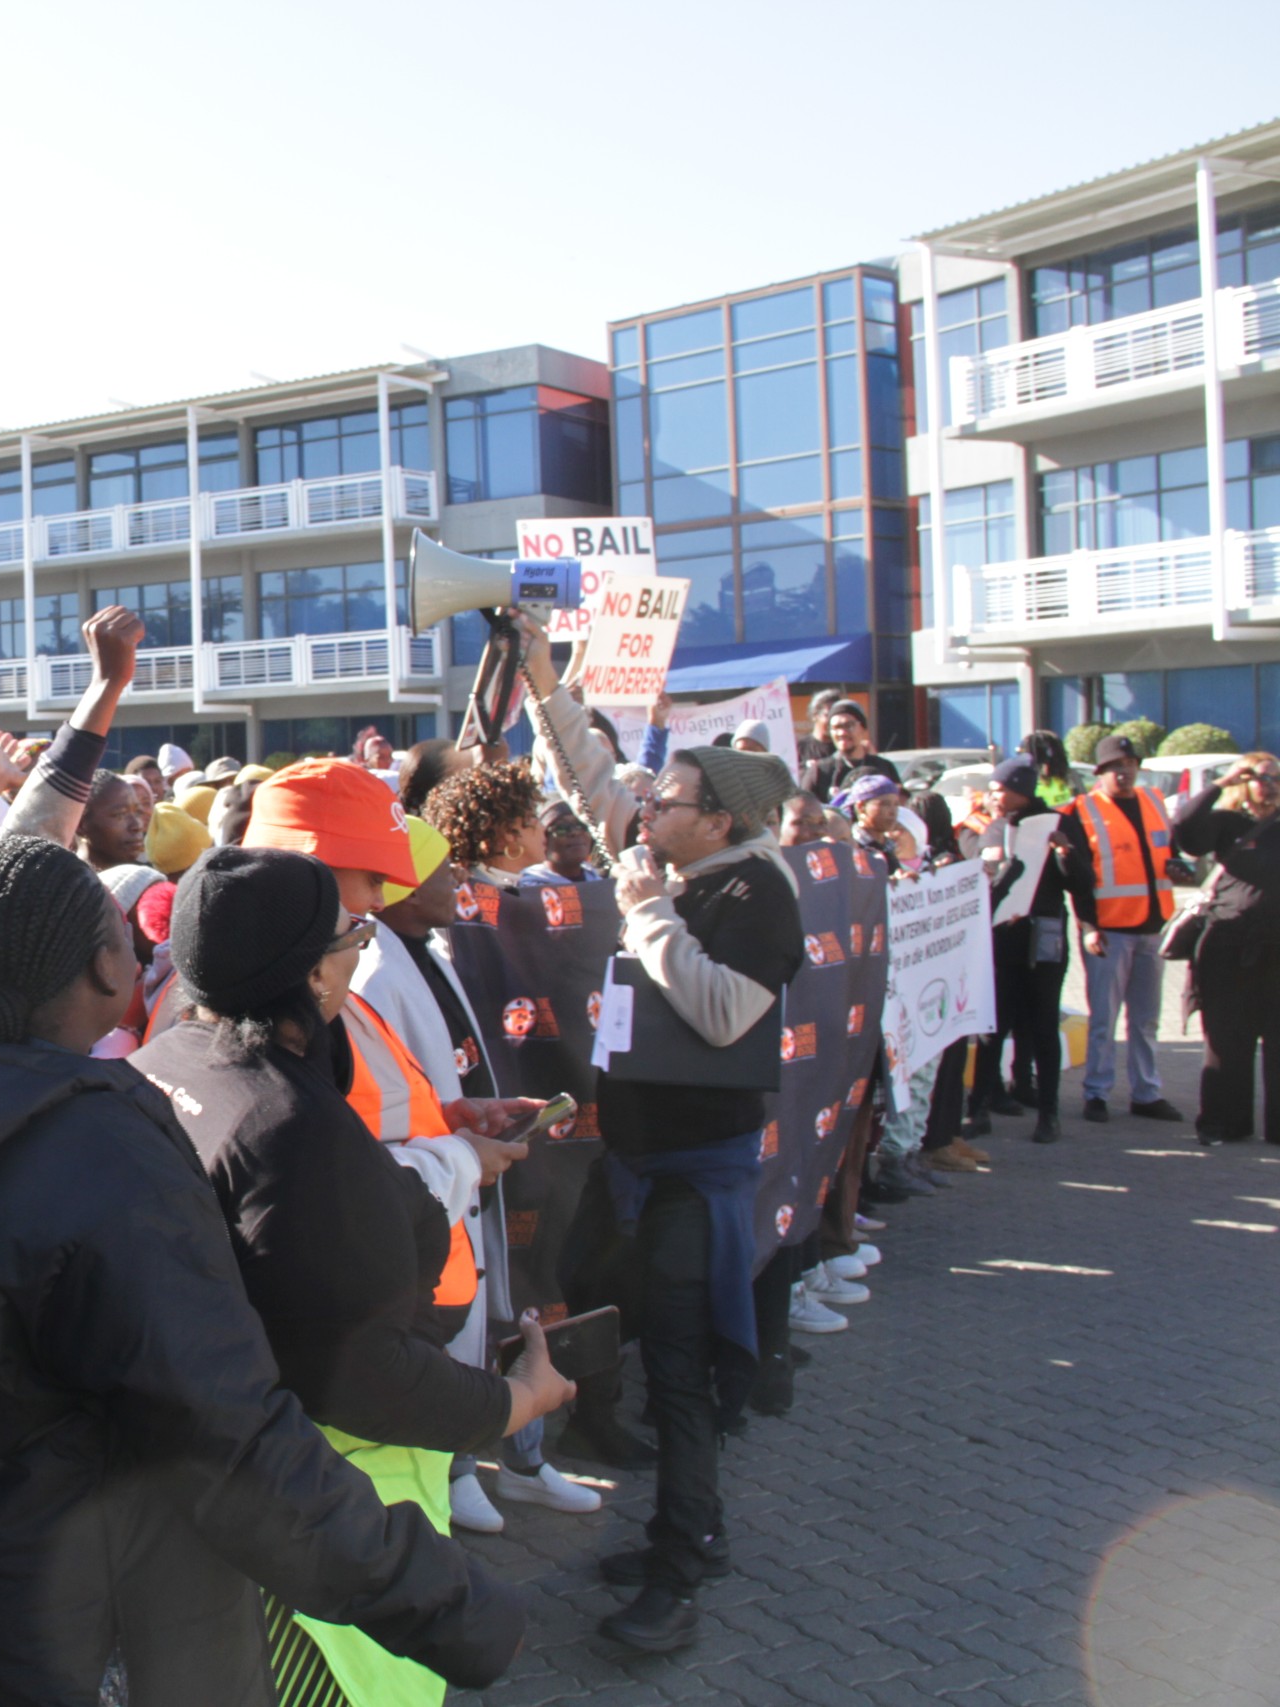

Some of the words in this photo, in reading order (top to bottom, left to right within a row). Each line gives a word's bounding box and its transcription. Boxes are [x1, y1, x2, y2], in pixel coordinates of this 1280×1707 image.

[523, 534, 563, 558] NO
[573, 526, 651, 556] BAIL
[523, 566, 555, 579] Hybrid
[601, 591, 632, 617] NO
[635, 588, 680, 620] BAIL
[616, 633, 654, 658] FOR
[582, 665, 666, 694] MURDERERS
